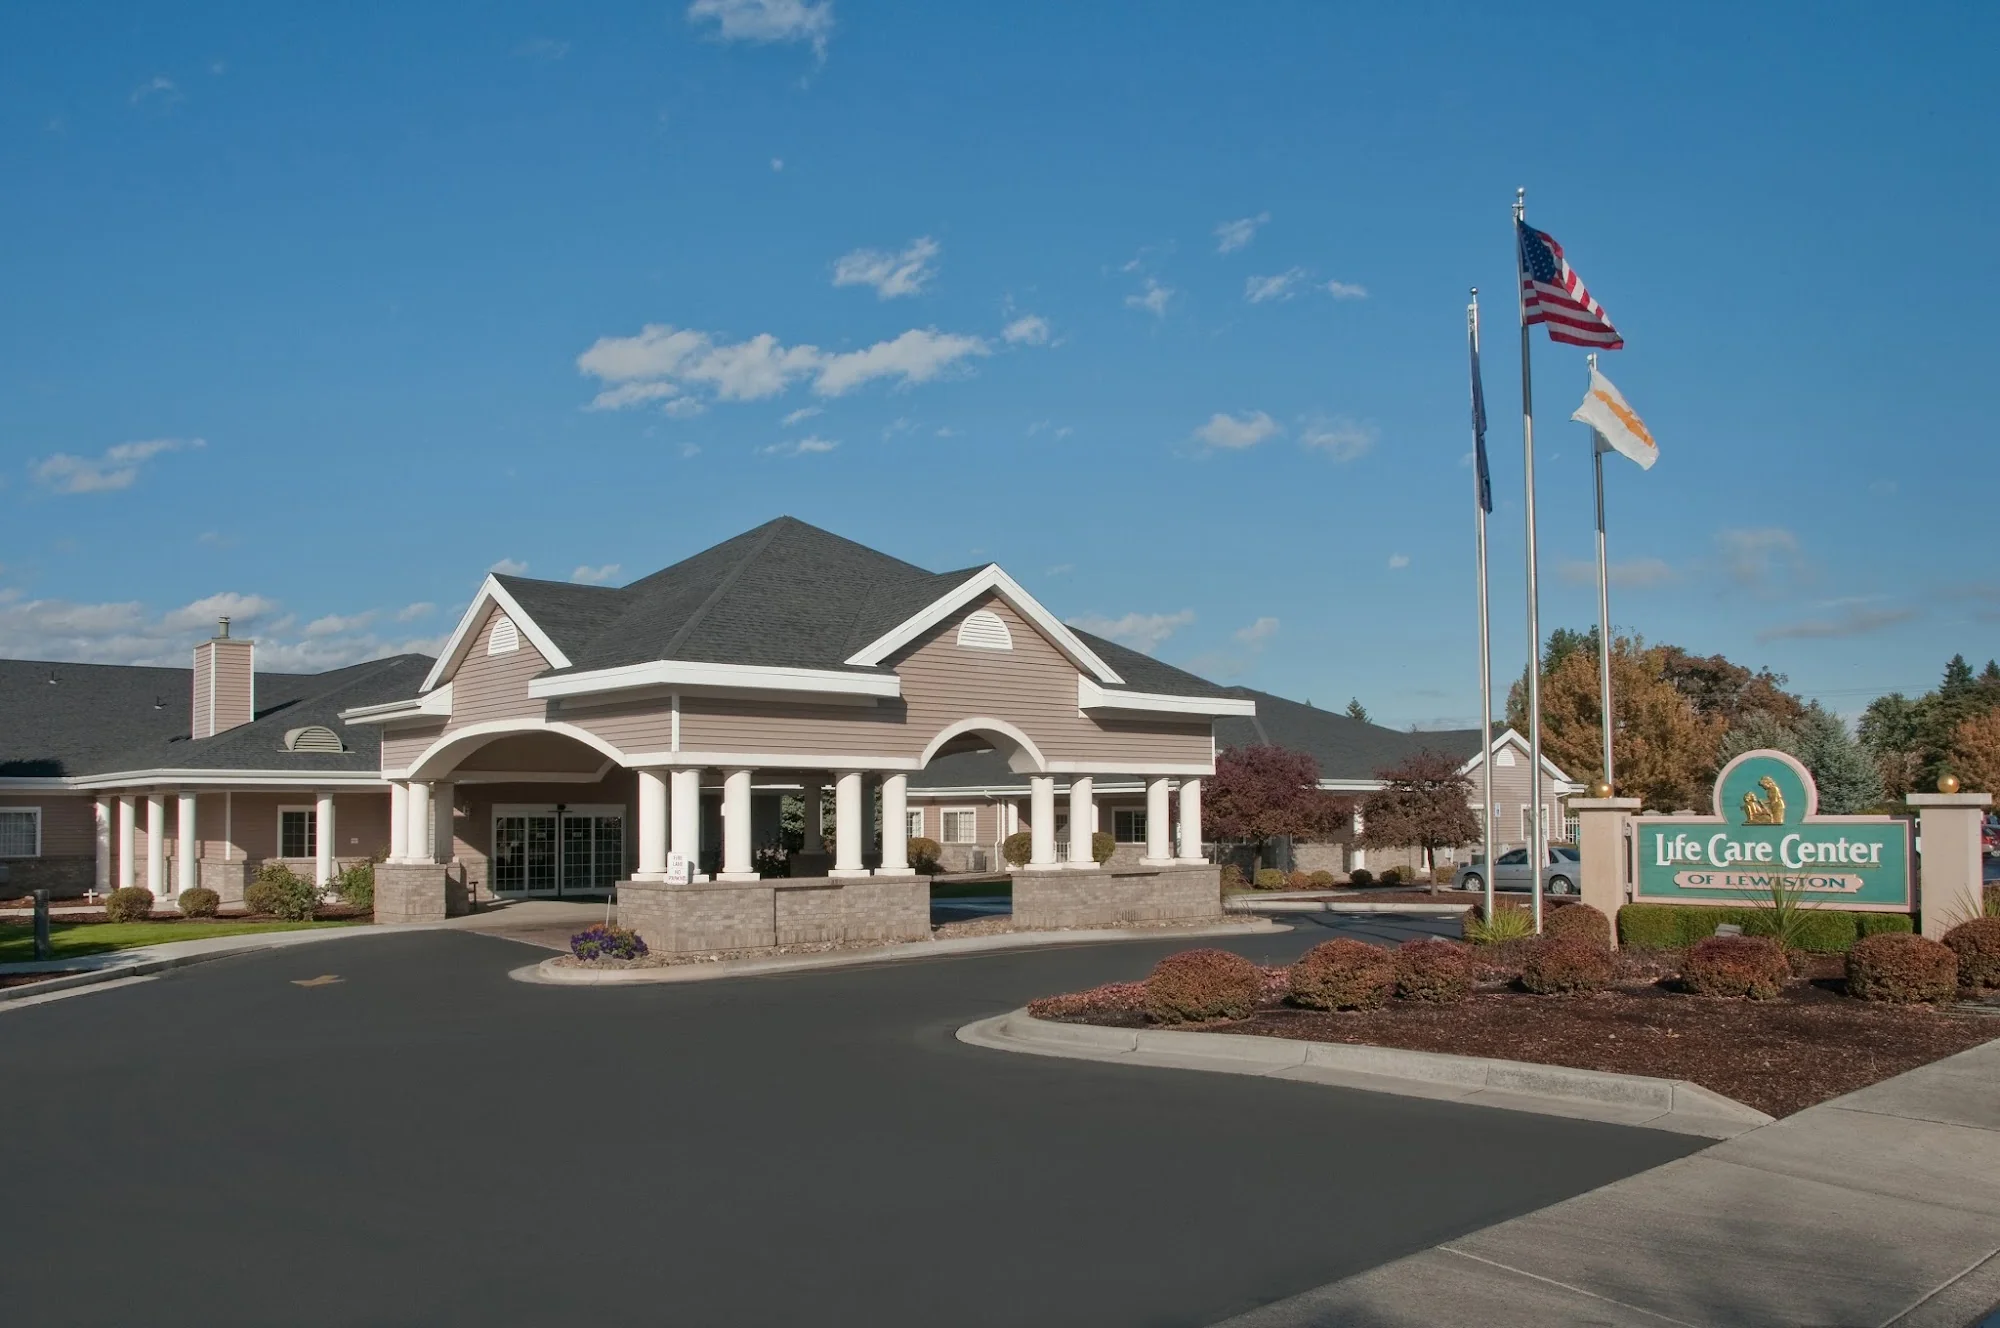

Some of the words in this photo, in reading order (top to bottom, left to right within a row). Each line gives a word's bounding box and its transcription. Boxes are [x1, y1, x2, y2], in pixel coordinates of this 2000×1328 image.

[1655, 833, 1702, 866] Life
[1707, 833, 1773, 867] Care
[1780, 833, 1883, 869] Center
[1687, 874, 1715, 885] OF
[1725, 875, 1846, 889] LEWISTON
